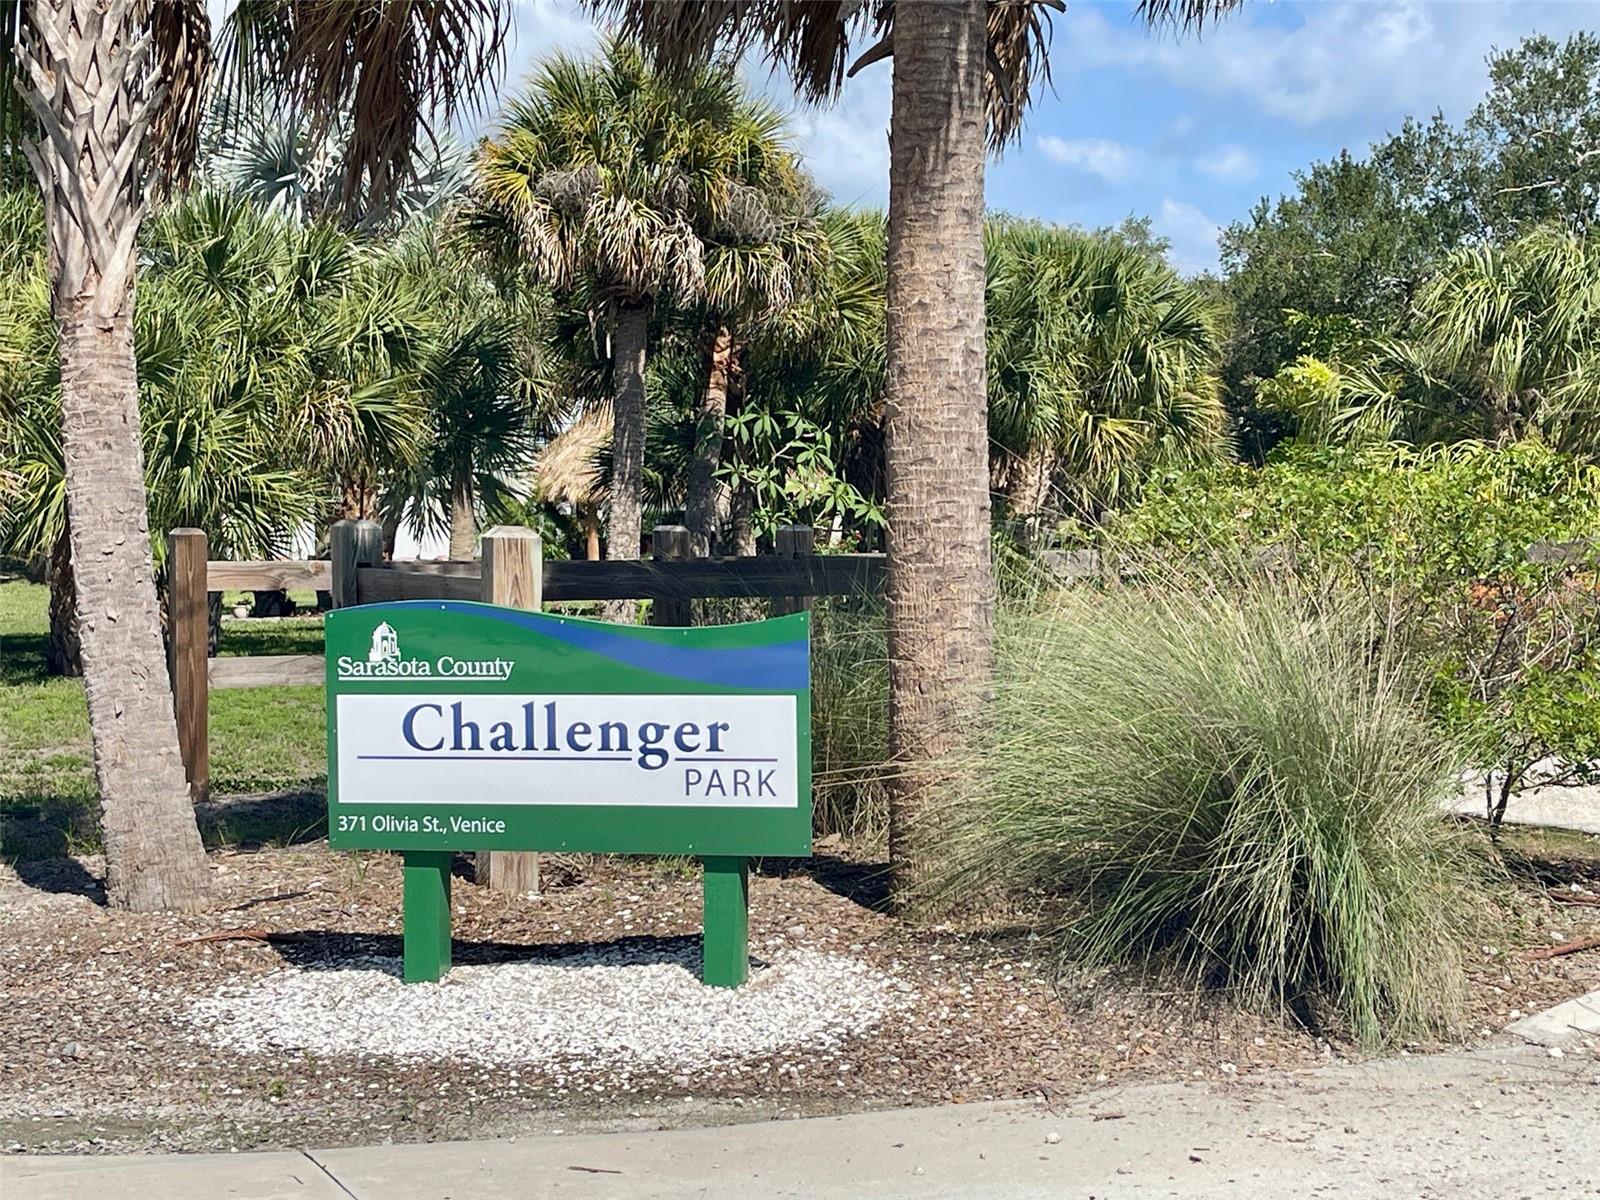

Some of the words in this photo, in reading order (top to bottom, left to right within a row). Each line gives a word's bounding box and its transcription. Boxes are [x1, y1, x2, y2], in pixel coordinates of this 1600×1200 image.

[337, 656, 431, 676] Sarasota
[437, 656, 515, 681] County
[402, 701, 730, 770] Challenger
[684, 768, 778, 797] PARK
[337, 815, 366, 832] 371
[372, 815, 419, 832] Olivia
[422, 816, 448, 835] St.,
[450, 816, 506, 833] Venice
